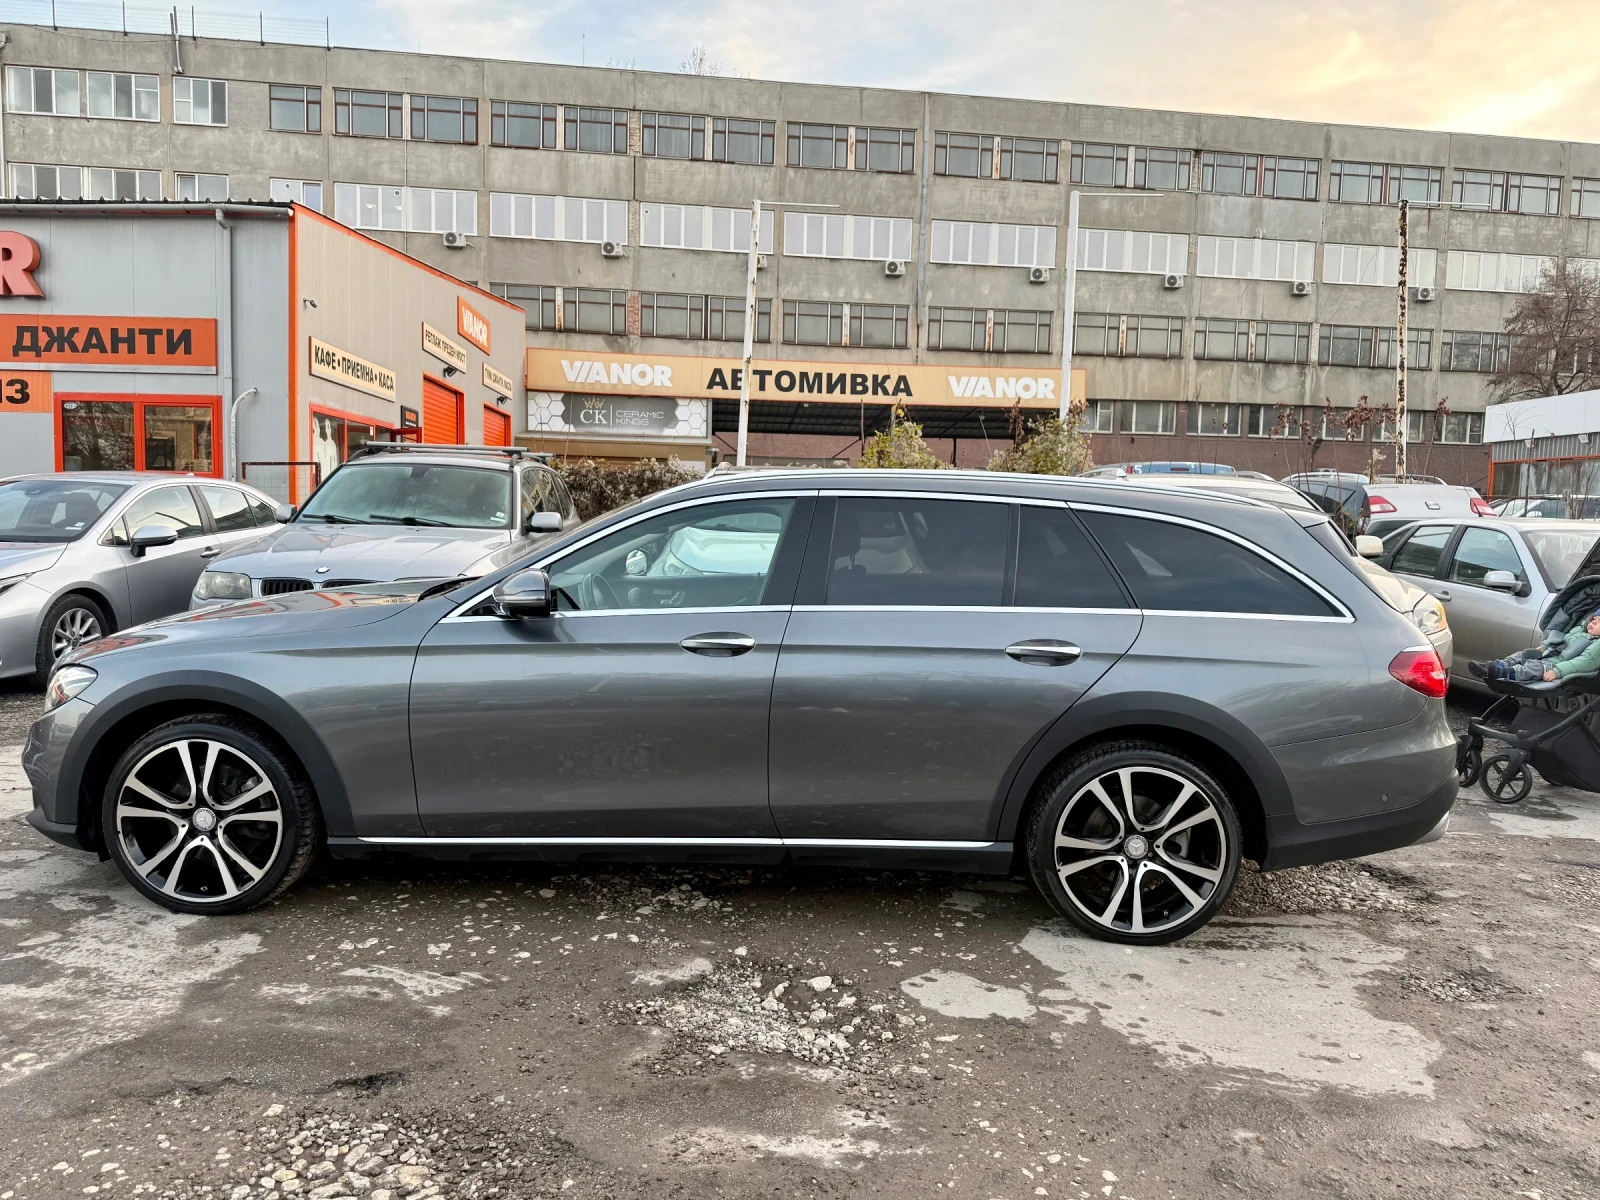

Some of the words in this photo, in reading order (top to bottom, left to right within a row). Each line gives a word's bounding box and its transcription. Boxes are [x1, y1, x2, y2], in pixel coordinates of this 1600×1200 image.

[12, 325, 192, 357] ДЖАНТИ
[314, 345, 336, 370] КАФЕ
[341, 356, 374, 384] ПРИЕМНА
[378, 371, 394, 391] КАСА
[560, 360, 673, 387] VIANOR
[947, 375, 1055, 399] VIANOR
[580, 409, 608, 424] CK
[616, 410, 665, 419] CERAMIC
[616, 418, 649, 426] KINGS
